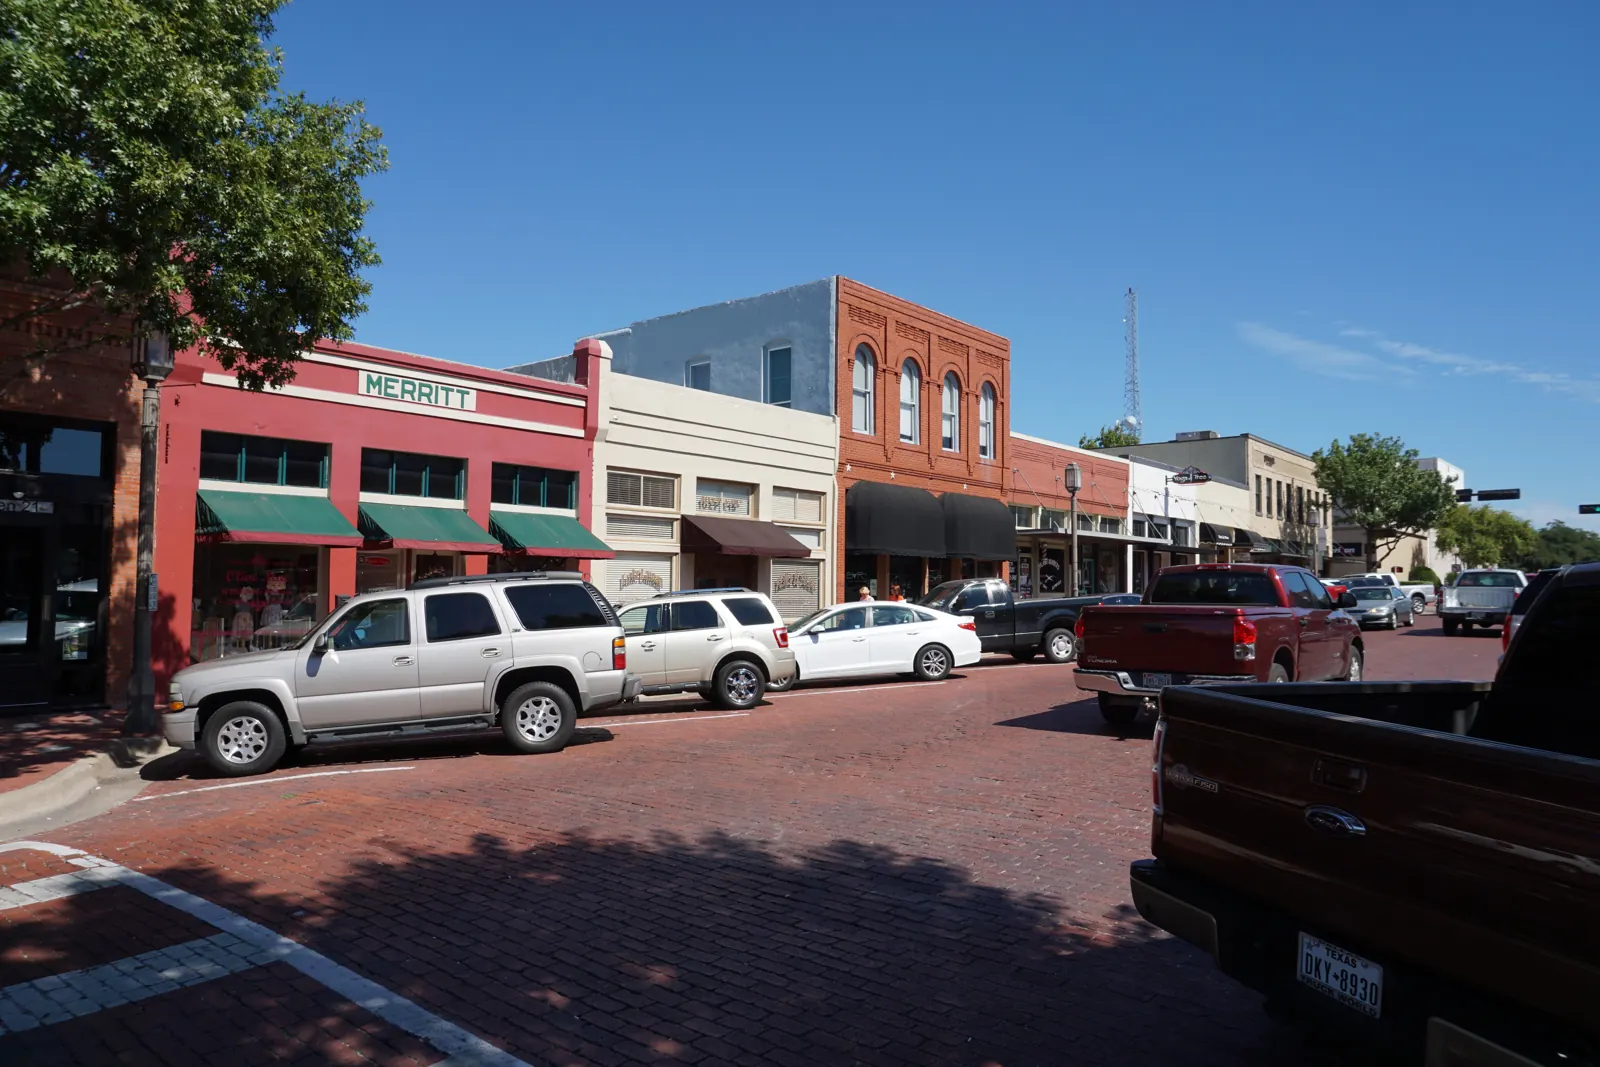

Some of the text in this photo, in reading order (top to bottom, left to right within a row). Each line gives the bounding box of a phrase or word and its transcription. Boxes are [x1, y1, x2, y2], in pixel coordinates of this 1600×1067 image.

[366, 373, 470, 409] MERRITT
[22, 500, 38, 513] 21
[1324, 946, 1357, 969] TEXAS
[1300, 974, 1377, 1018] TRUCK WORLD
[1305, 952, 1378, 1006] DKY 8930
